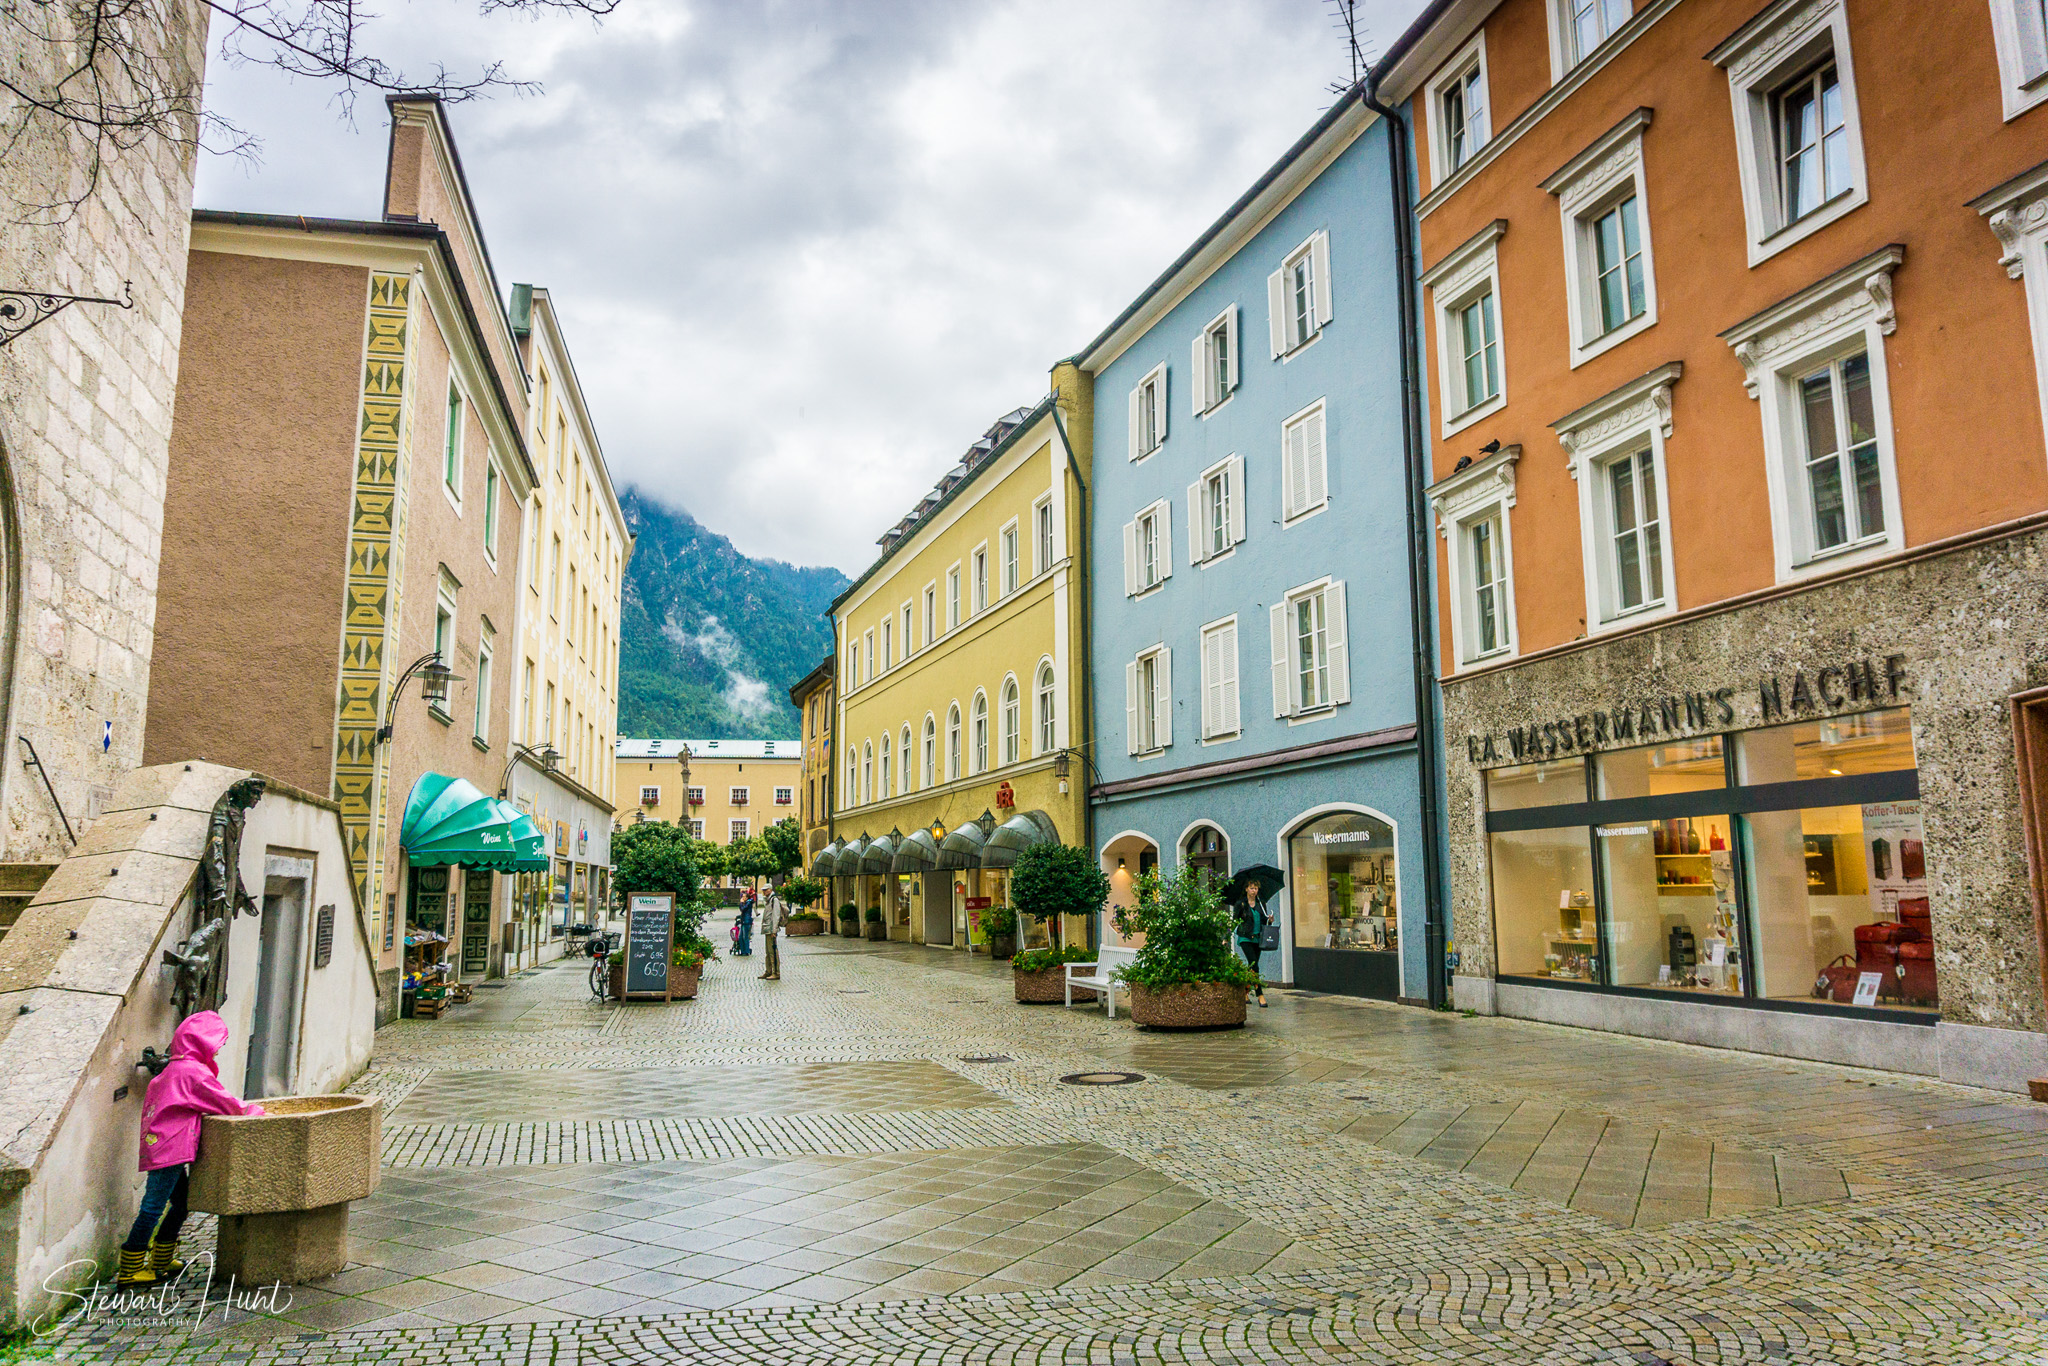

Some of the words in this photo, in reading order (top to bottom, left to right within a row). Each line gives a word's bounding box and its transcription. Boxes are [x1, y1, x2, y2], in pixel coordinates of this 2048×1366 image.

[1507, 687, 1734, 759] WASSERMANN'S
[1312, 830, 1370, 845] Wassermanns
[1596, 825, 1649, 837] Wassermanns
